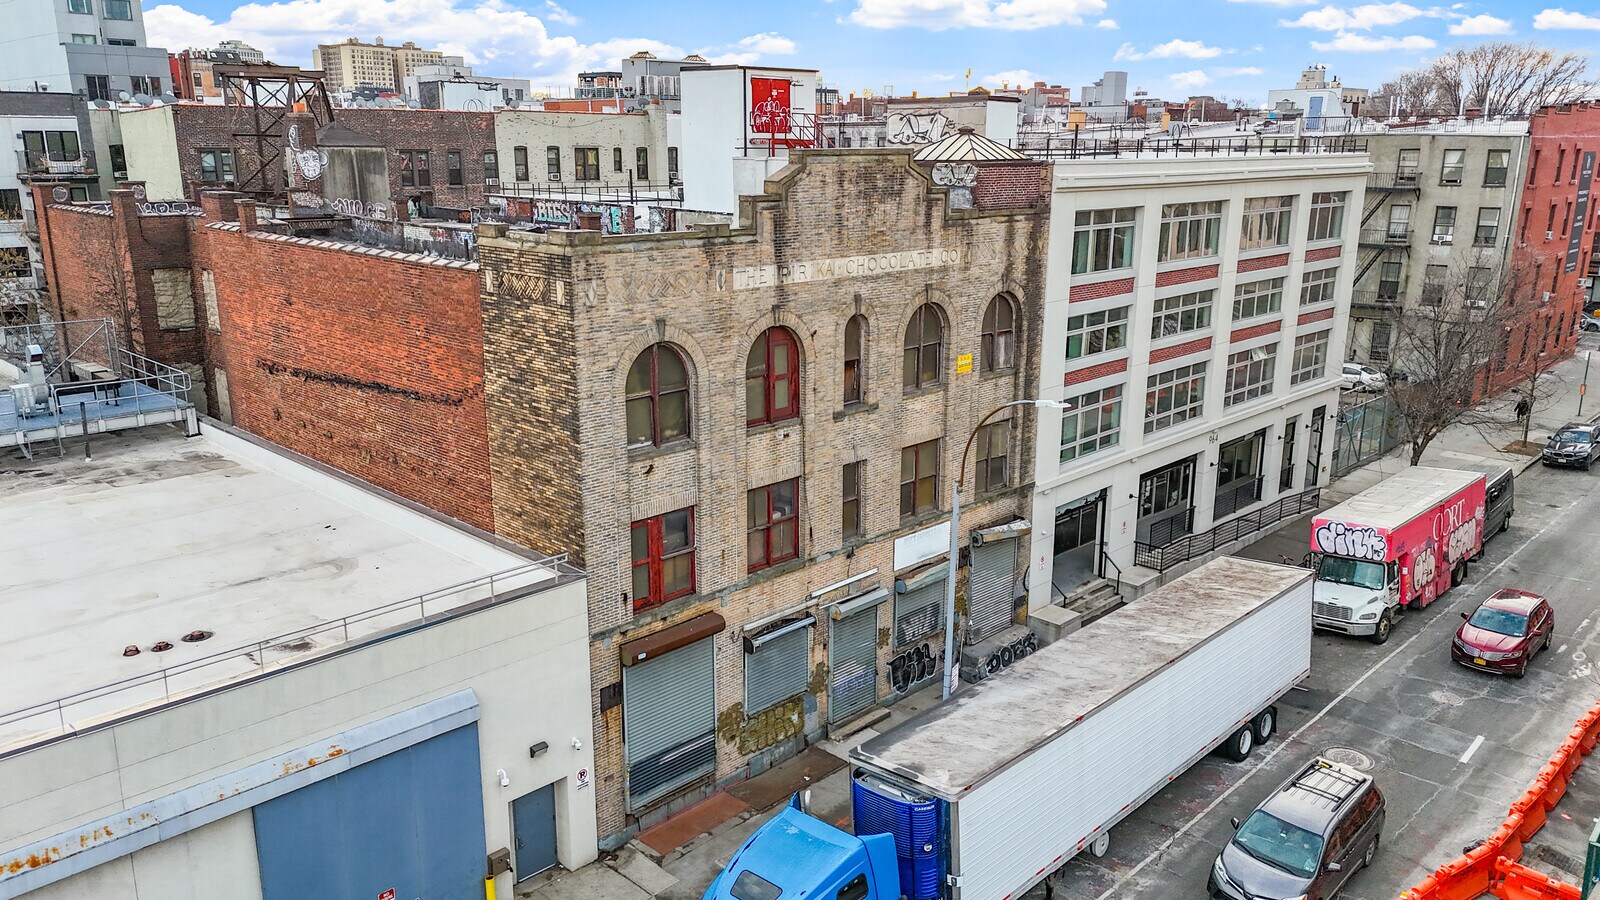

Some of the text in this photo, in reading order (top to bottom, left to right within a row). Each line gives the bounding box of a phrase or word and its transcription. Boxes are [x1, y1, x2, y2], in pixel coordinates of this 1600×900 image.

[735, 268, 768, 288] THE
[845, 250, 932, 275] CHOCOLATE
[940, 248, 958, 264] CO
